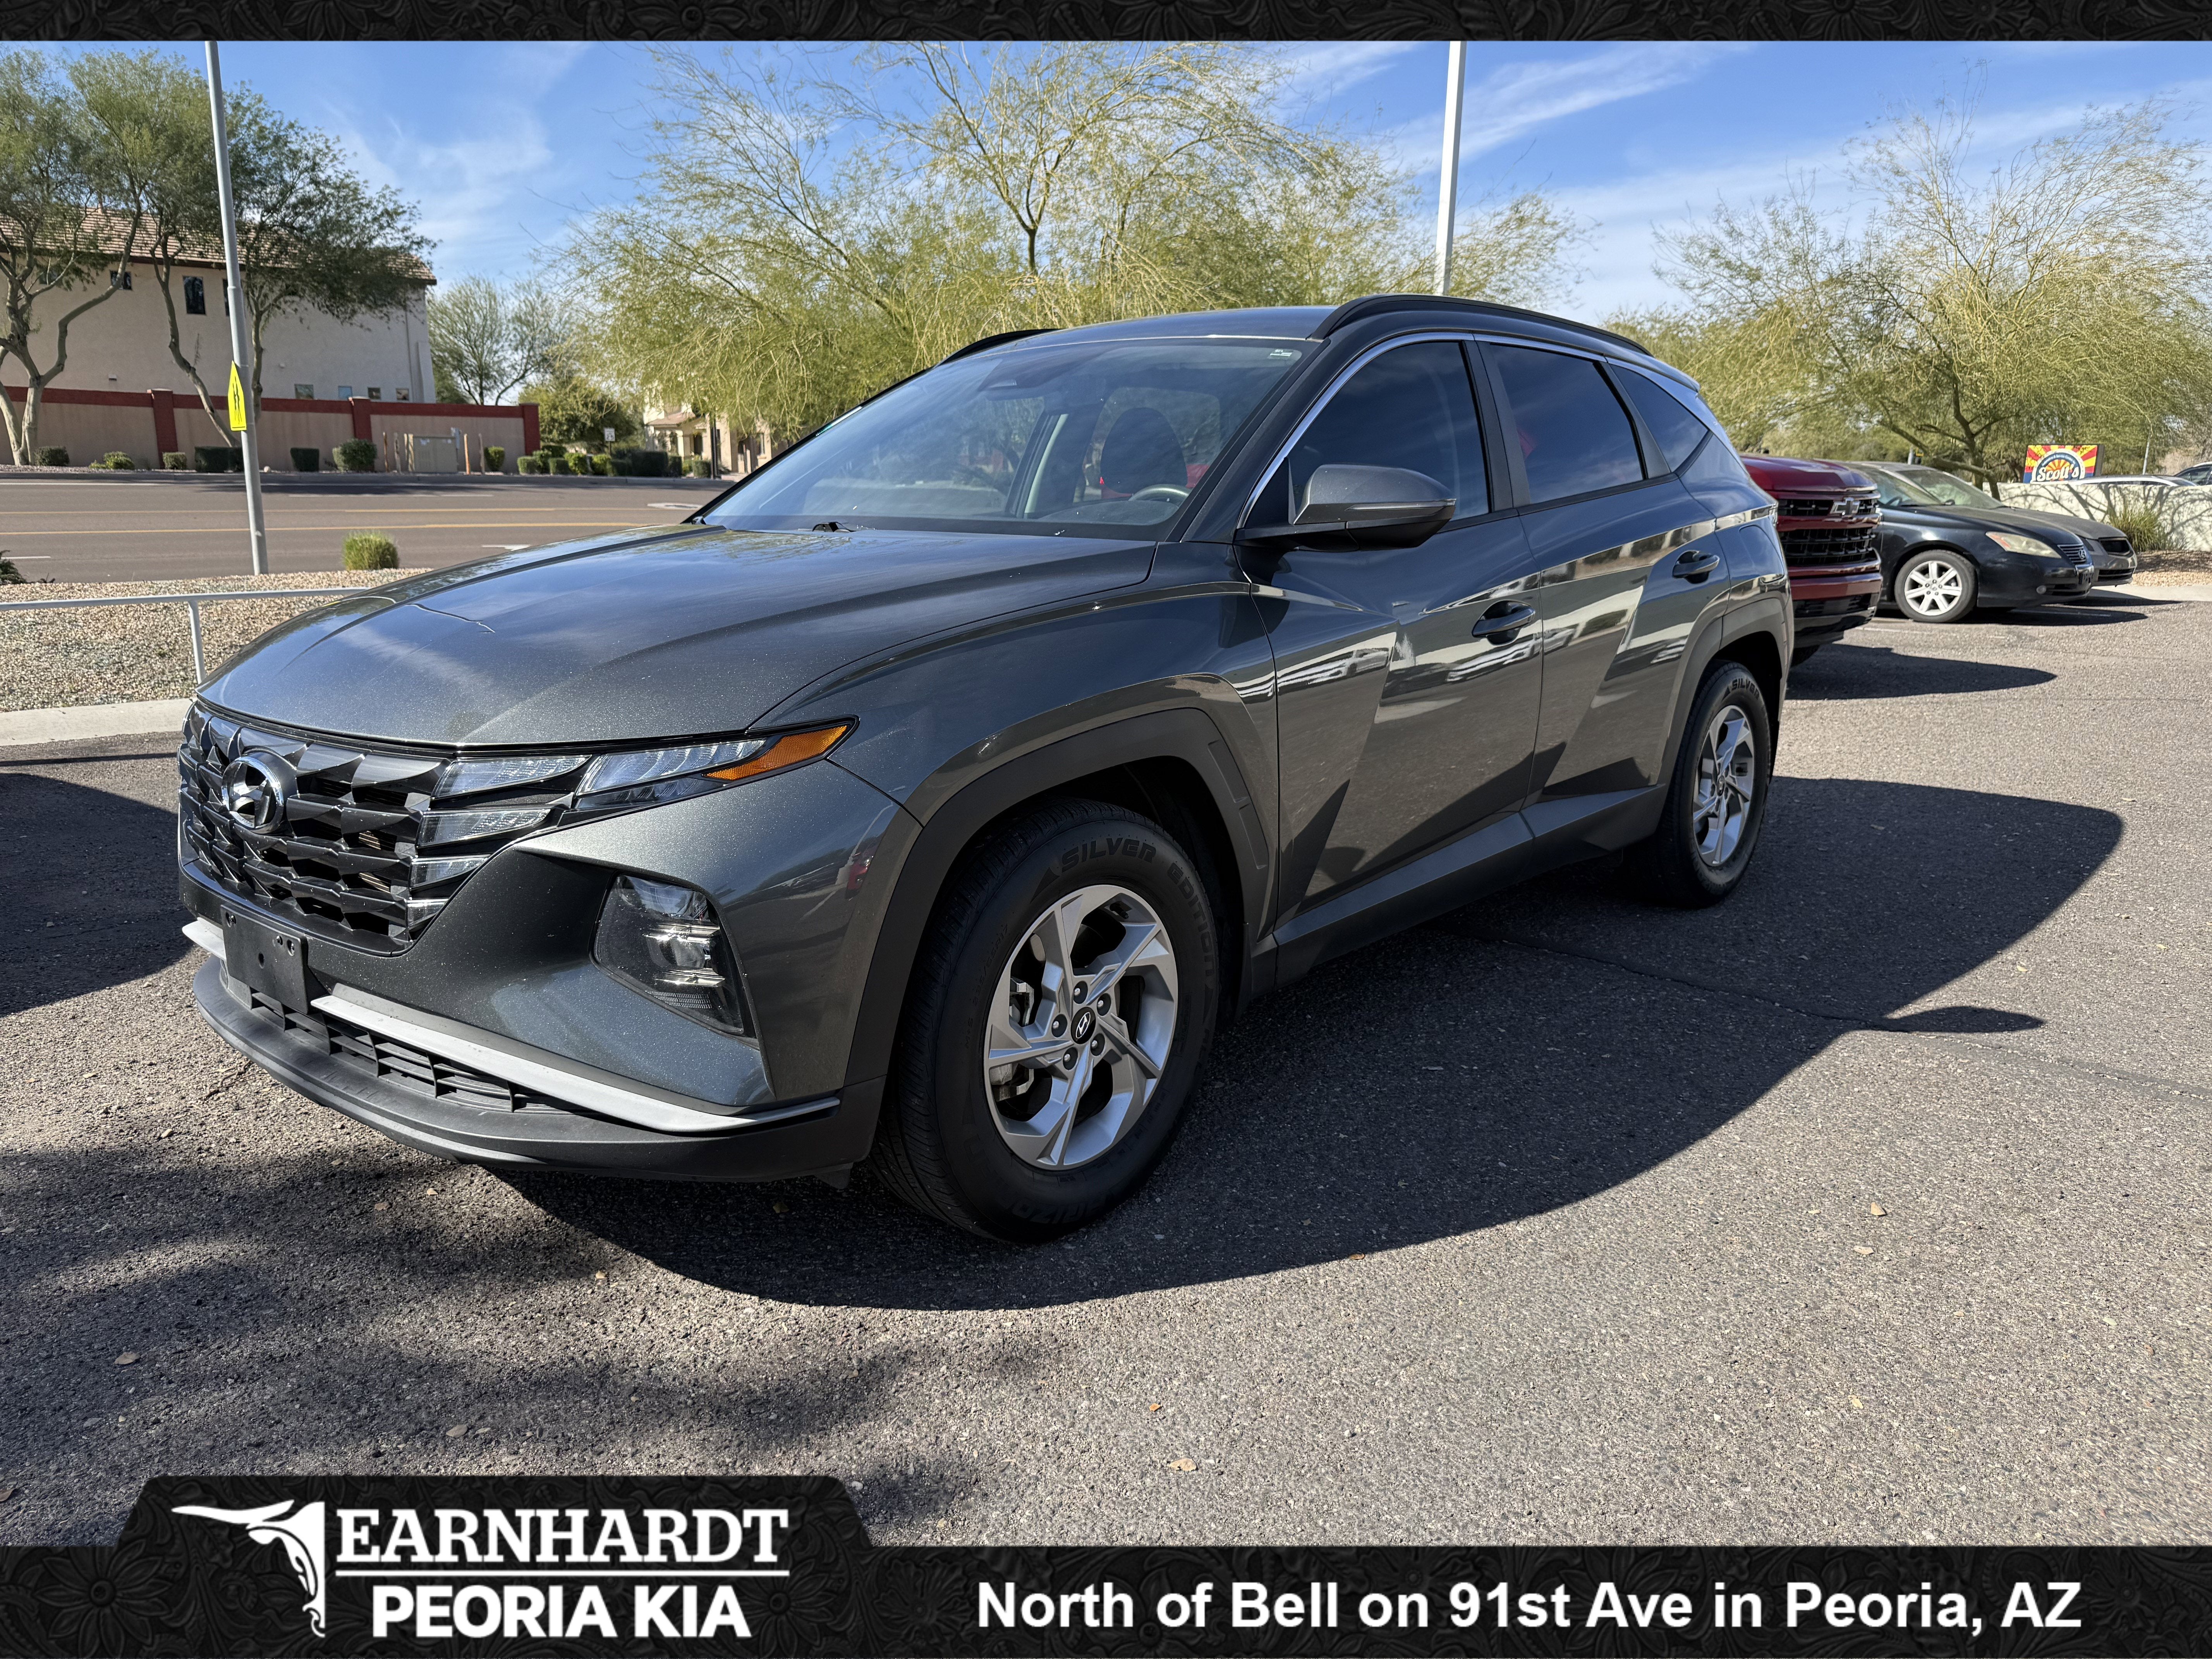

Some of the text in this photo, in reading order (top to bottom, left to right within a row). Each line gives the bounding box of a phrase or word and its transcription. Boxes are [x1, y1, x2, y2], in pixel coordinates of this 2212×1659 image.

[2037, 464, 2079, 482] Scott's
[1731, 678, 1760, 701] SILVER
[1061, 837, 1215, 977] SILVER EDITION
